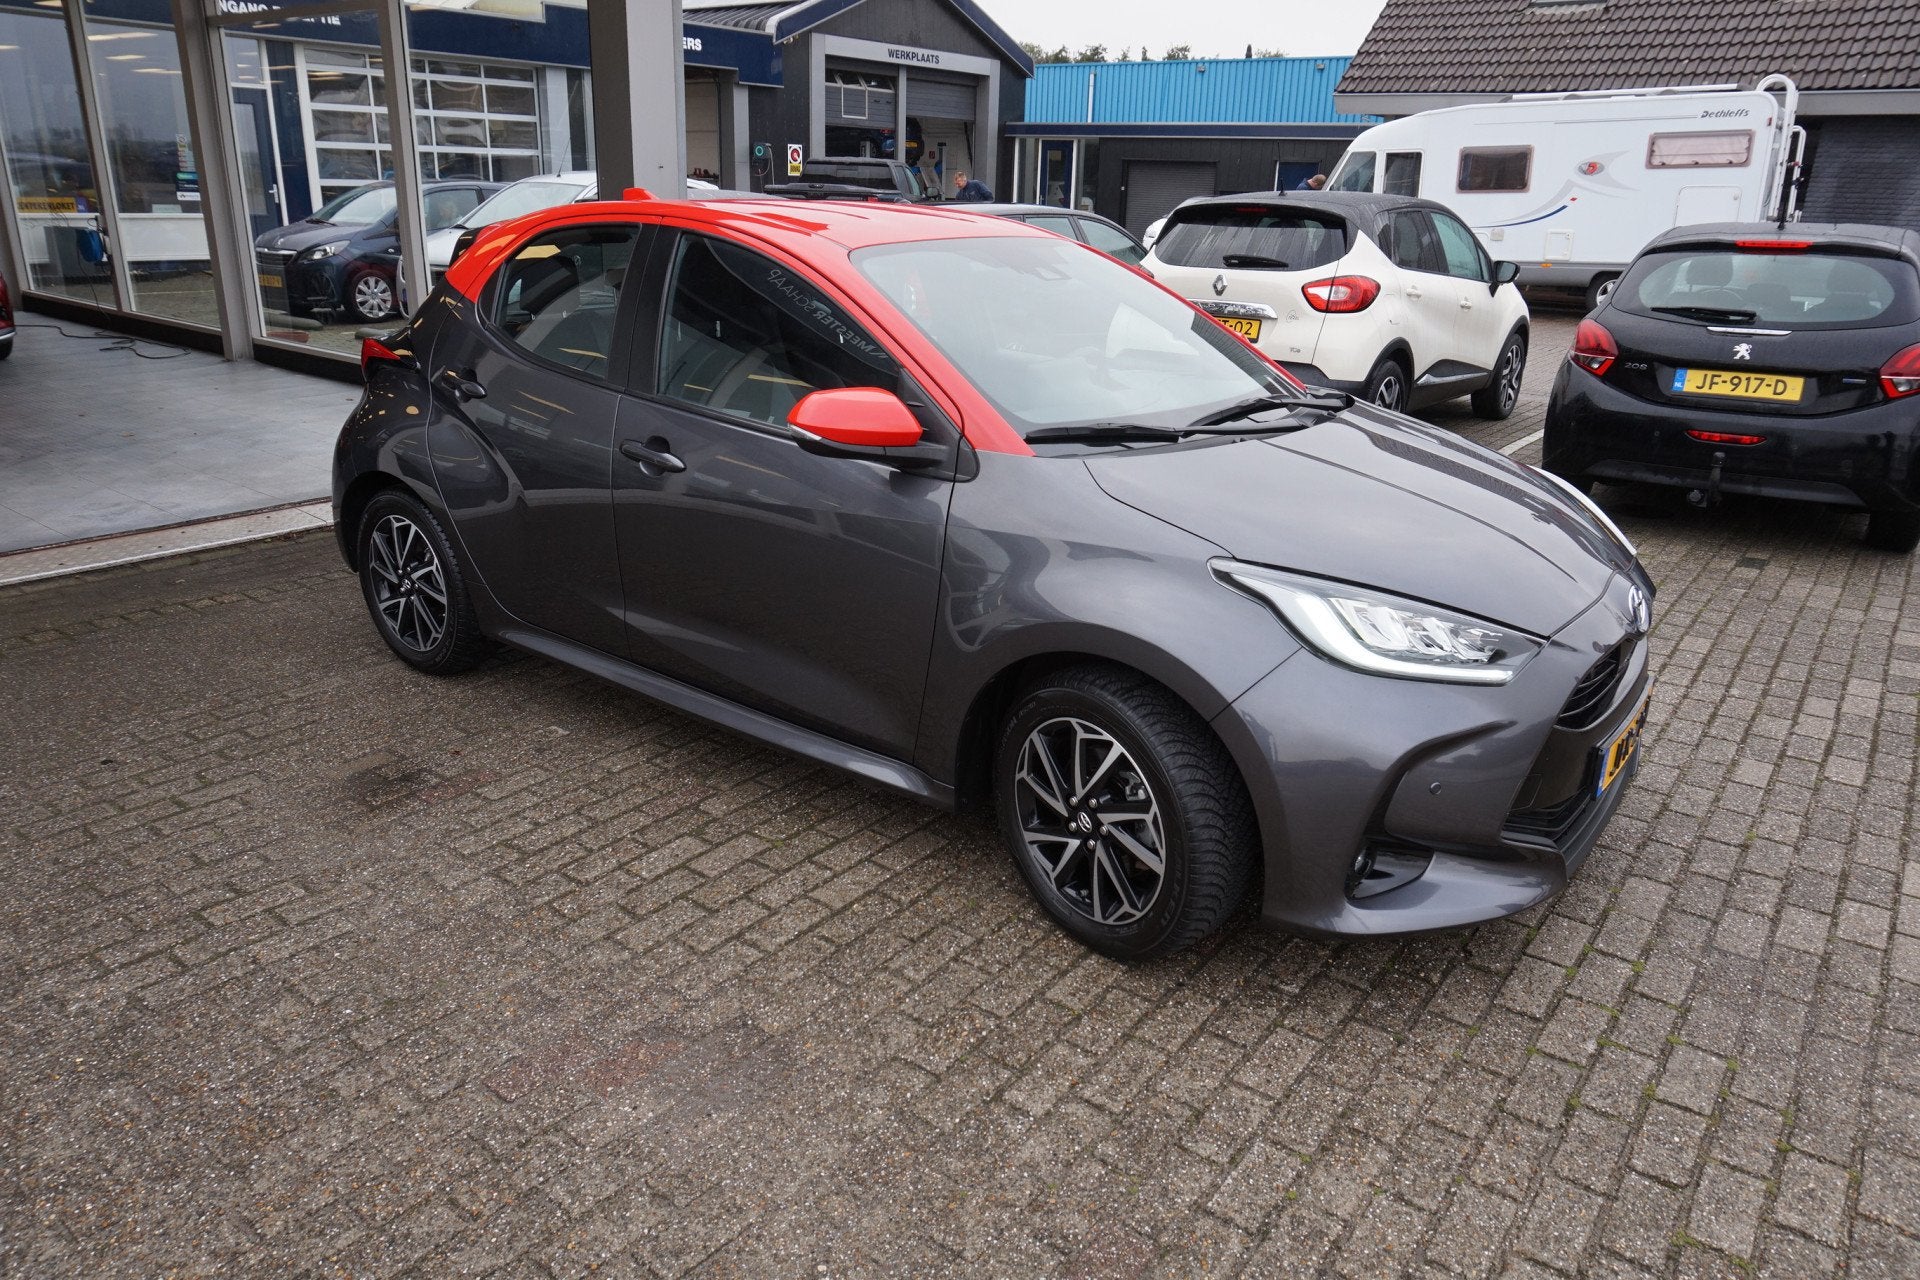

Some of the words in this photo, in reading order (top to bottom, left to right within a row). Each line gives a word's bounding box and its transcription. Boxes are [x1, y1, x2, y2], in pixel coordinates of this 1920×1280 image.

[887, 48, 940, 65] WERKPLAATS
[1700, 109, 1750, 118] Dethleffs
[1695, 373, 1788, 396] JF-917-D
